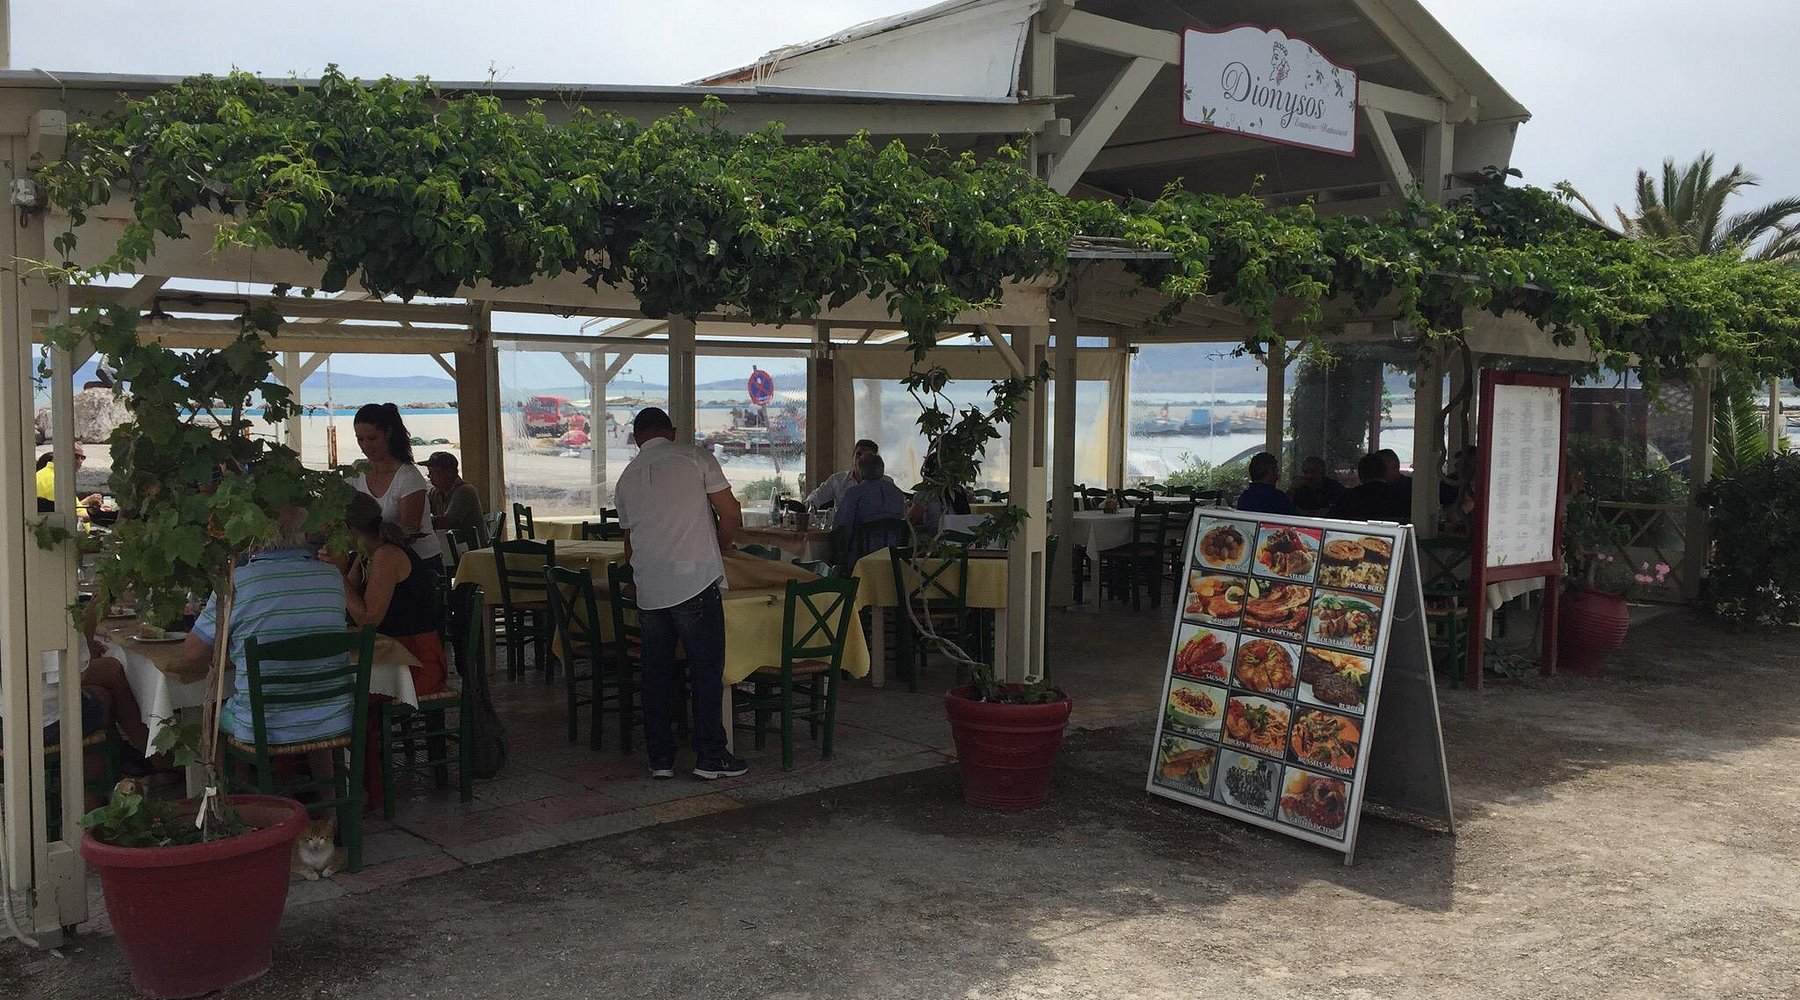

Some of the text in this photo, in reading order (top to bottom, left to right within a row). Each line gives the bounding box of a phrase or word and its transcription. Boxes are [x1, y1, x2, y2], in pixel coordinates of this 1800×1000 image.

[1221, 61, 1326, 128] Dionysos
[1350, 581, 1366, 590] PORK
[1322, 763, 1353, 775] SAGANAKI
